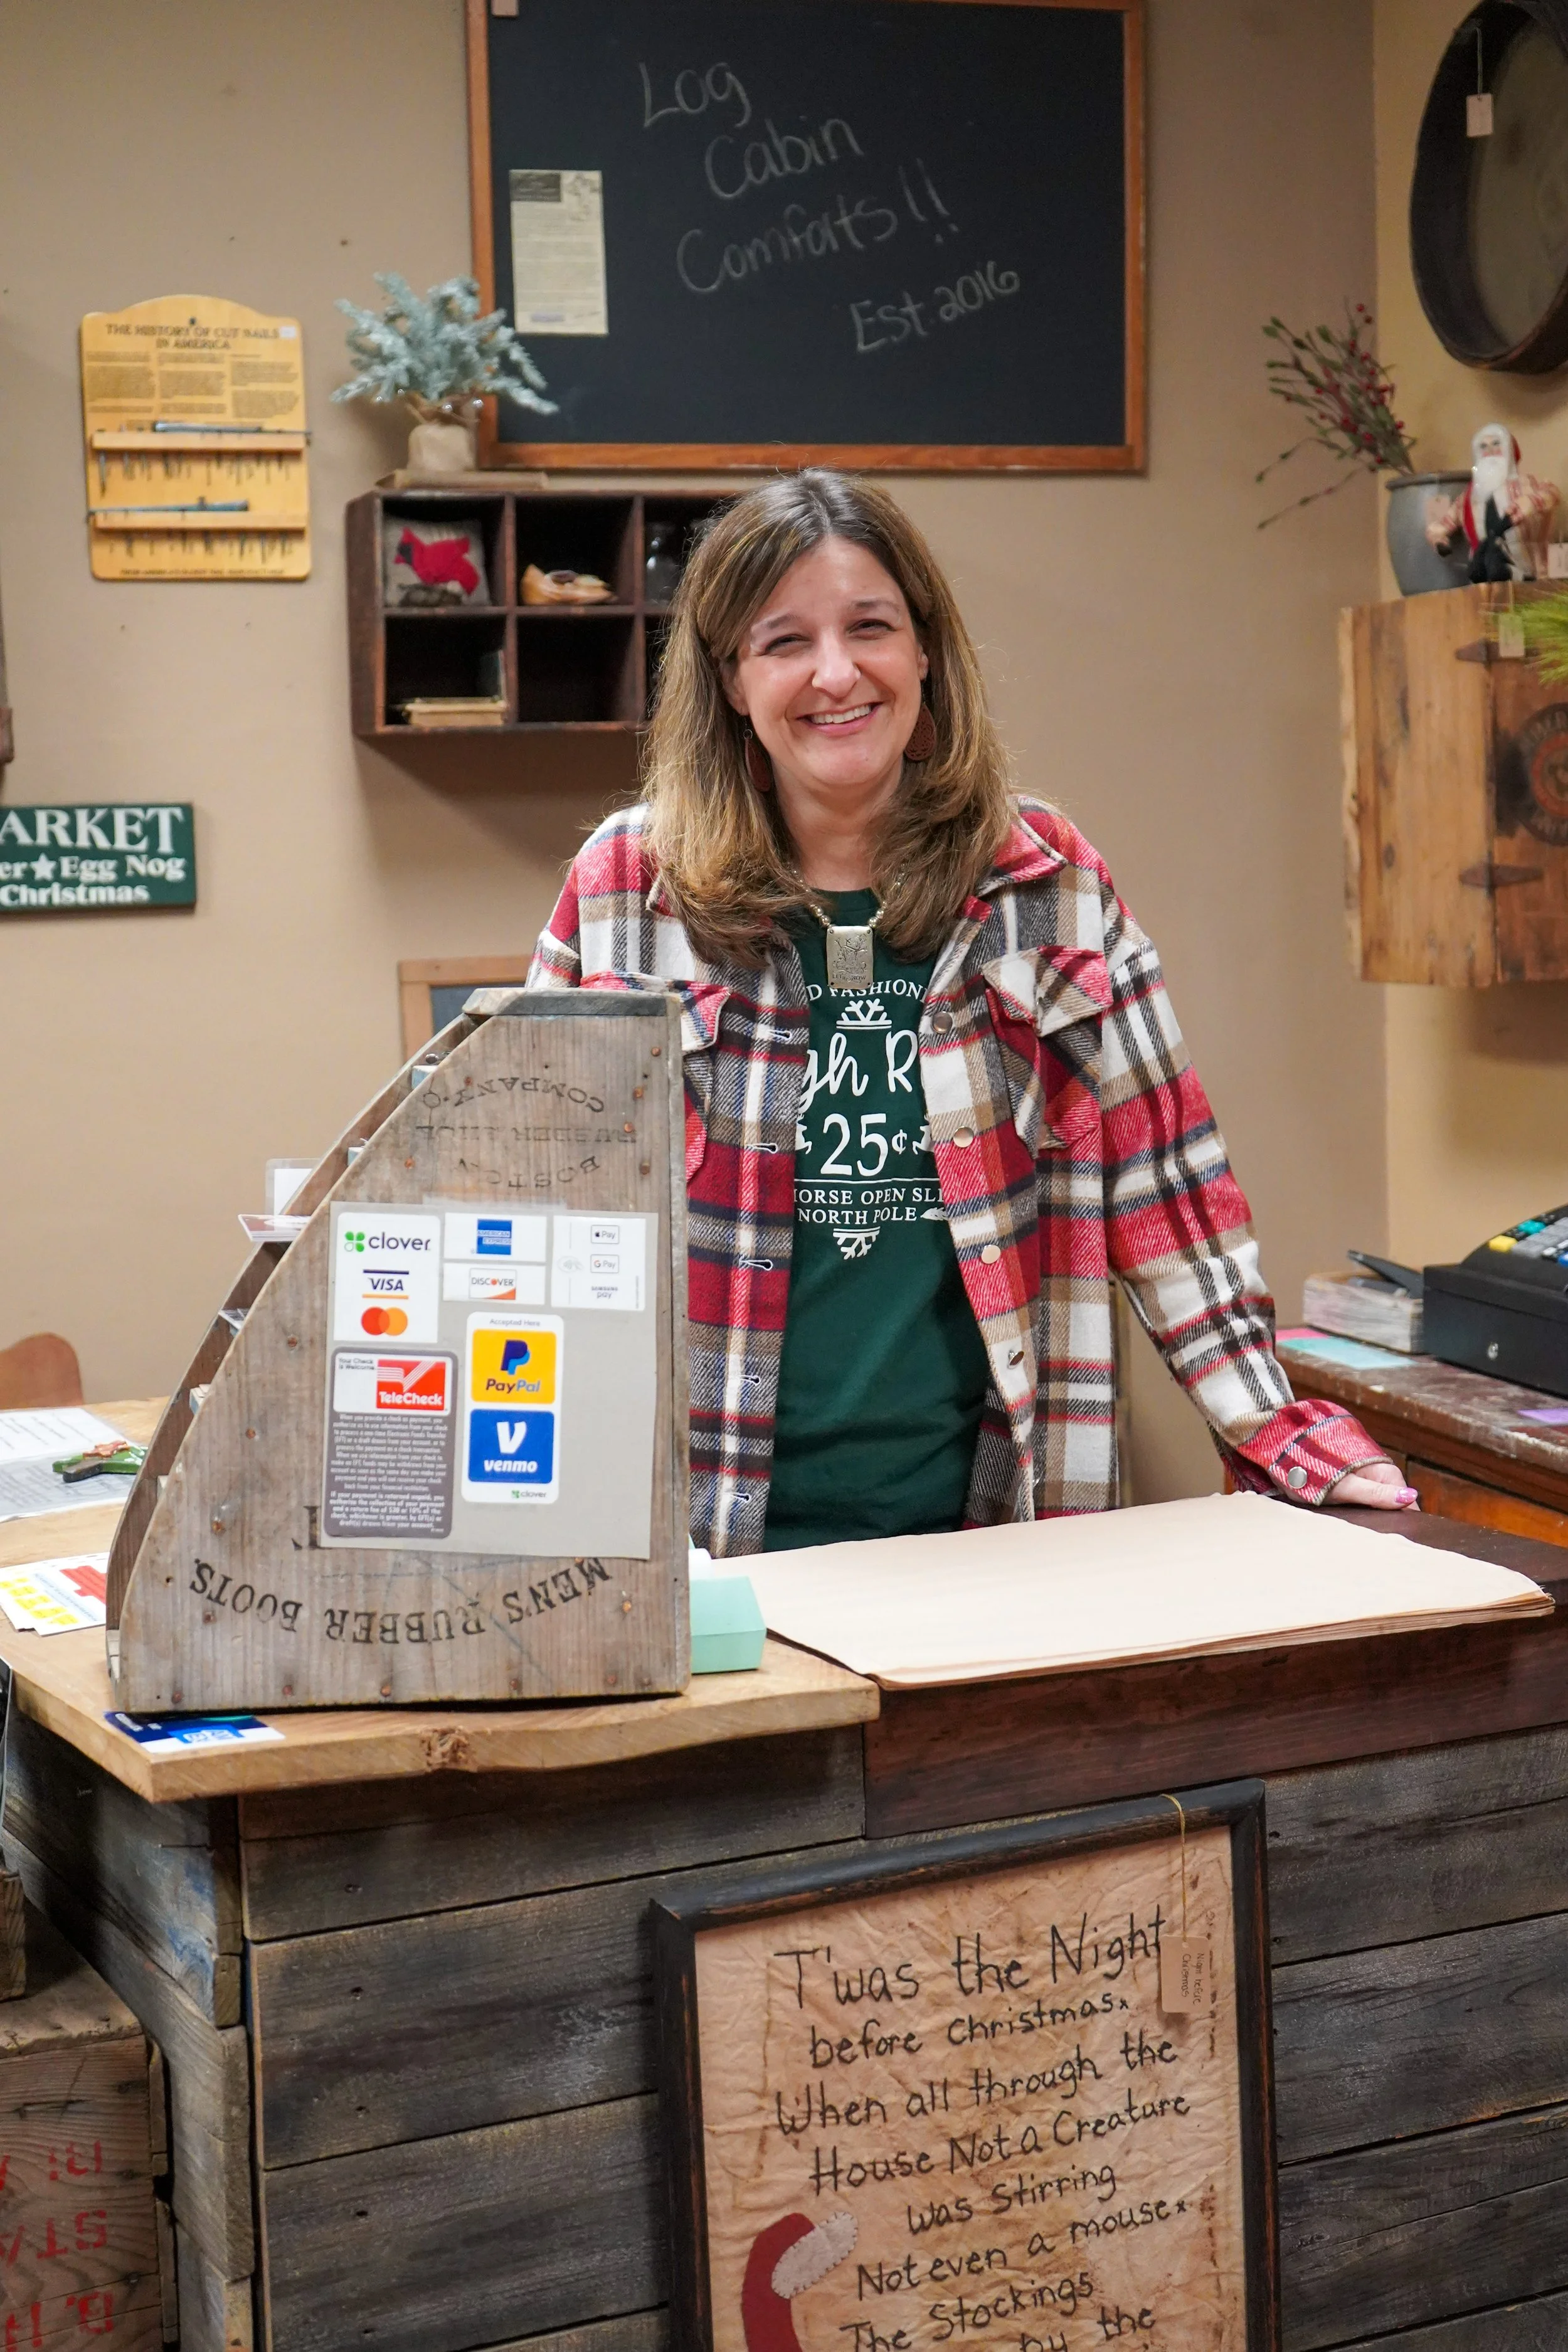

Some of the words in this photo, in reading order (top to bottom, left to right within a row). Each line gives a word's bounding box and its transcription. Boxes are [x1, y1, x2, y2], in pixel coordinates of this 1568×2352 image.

[638, 61, 751, 127] Log
[704, 115, 864, 199] Cabin
[934, 260, 1020, 322] 2016
[60, 855, 118, 883] Egg
[125, 854, 187, 882] Nog
[0, 881, 151, 906] Christmas
[861, 1187, 906, 1205] OPEN
[797, 1207, 869, 1226] NORTH
[872, 1206, 918, 1224] POLE
[368, 1231, 432, 1251] clover
[601, 1230, 616, 1239] Pay
[602, 1259, 616, 1269] Pay
[368, 1277, 404, 1291] VISA
[471, 1276, 514, 1286] DISCOVER
[489, 1318, 522, 1327] Accepted
[378, 1391, 443, 1406] TeleCheck
[485, 1378, 541, 1394] PayPal
[484, 1459, 538, 1473] venmo
[521, 1490, 547, 1498] clover
[323, 1601, 486, 1645] RUBBER
[773, 1945, 920, 2009] T'was
[953, 1932, 1030, 1997] the
[1050, 1904, 1167, 1983] Night
[810, 2019, 924, 2069] before
[776, 2080, 888, 2136] When
[906, 2077, 950, 2117] all
[968, 2043, 1103, 2107] through
[1120, 2029, 1177, 2071] the
[809, 2145, 936, 2196] House
[949, 2124, 1012, 2175] Not
[1052, 2087, 1191, 2147] Creature
[857, 2254, 922, 2302] Not
[928, 2246, 1008, 2284] even
[1027, 2232, 1057, 2257] a
[839, 2320, 914, 2352] The
[1096, 2305, 1157, 2342] the
